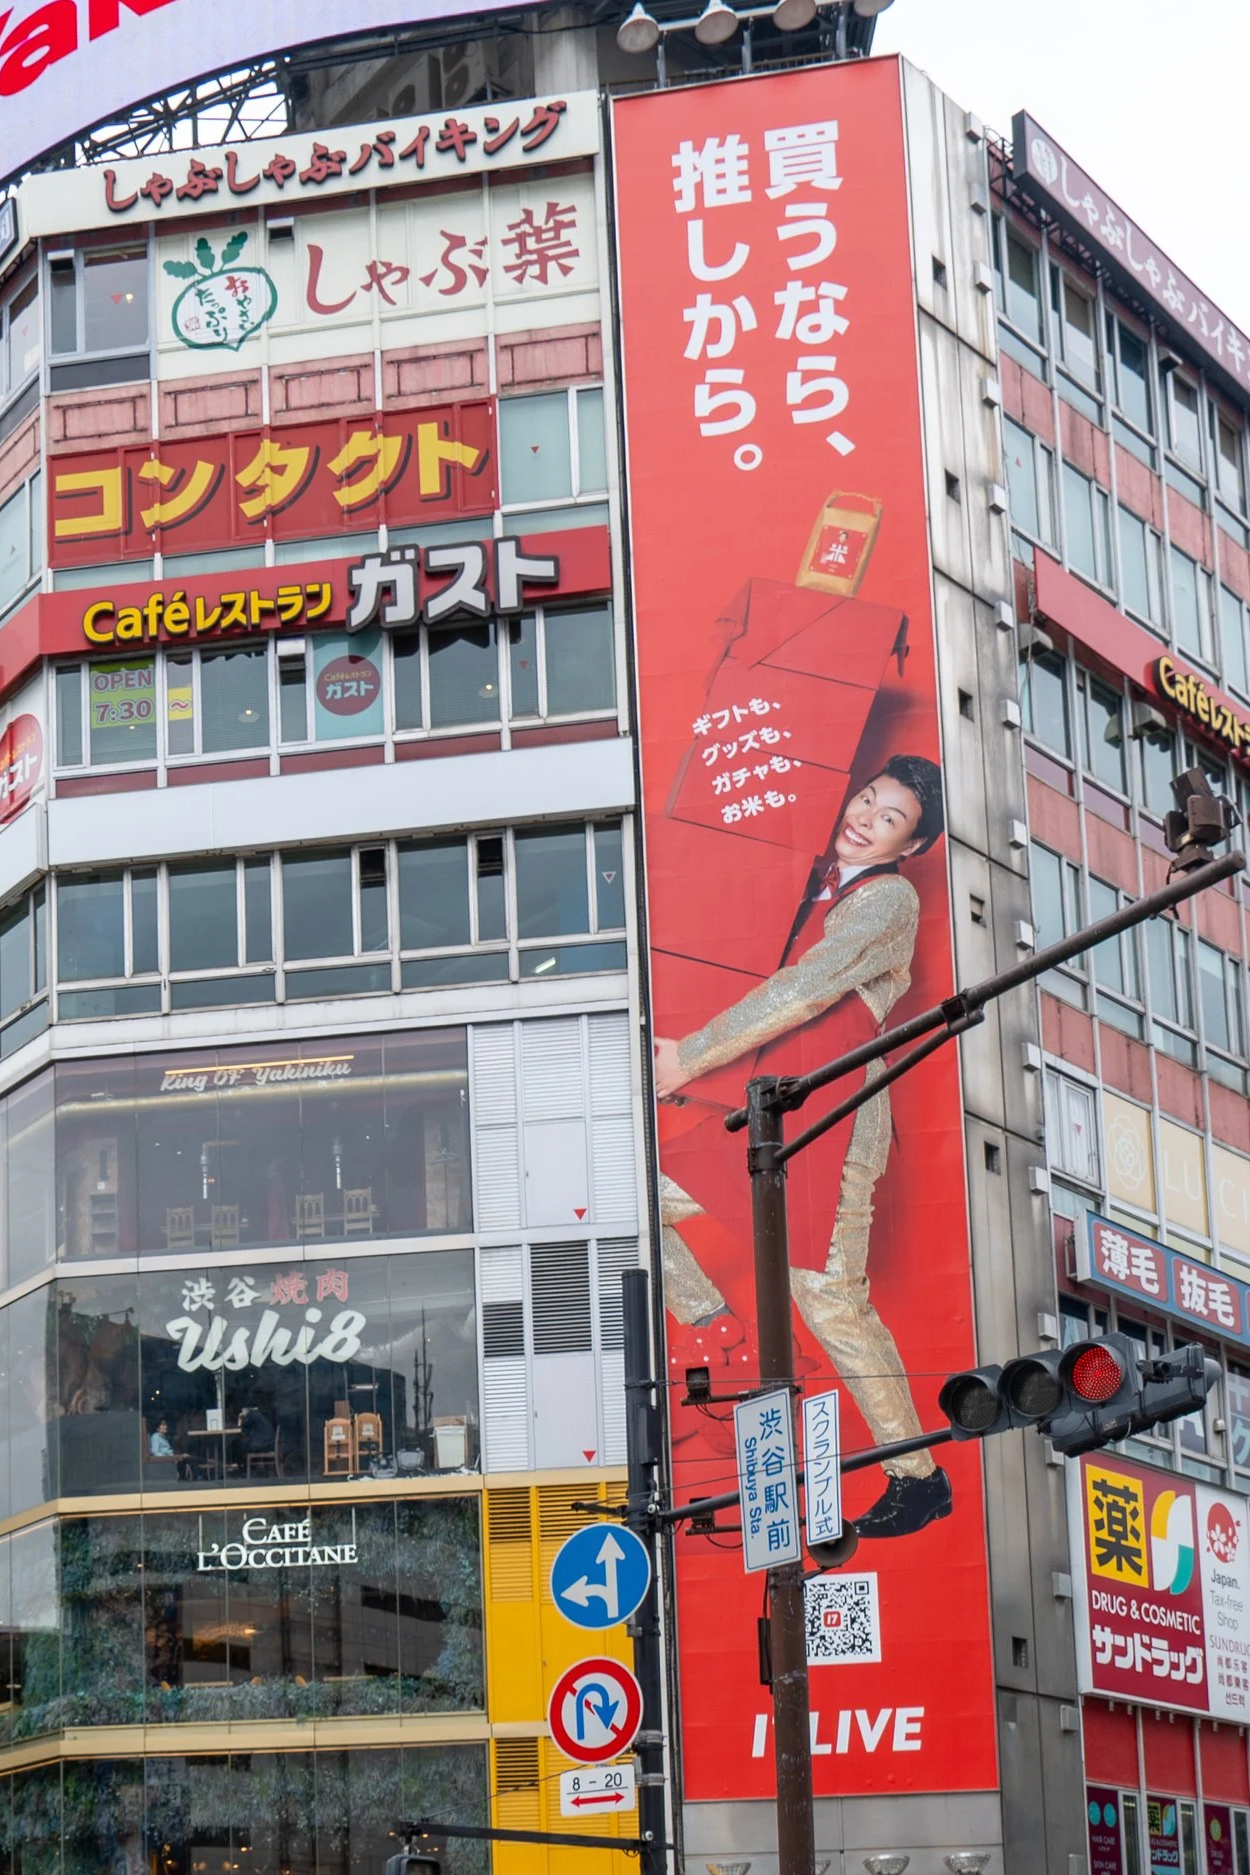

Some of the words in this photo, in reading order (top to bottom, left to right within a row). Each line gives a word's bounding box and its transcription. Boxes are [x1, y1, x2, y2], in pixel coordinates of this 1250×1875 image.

[103, 100, 567, 212] しゃぶしゃぶバイキング
[306, 200, 580, 316] しゃぶ葉
[763, 119, 856, 457] 買うなら、
[1060, 154, 1250, 383] しゃぶしゃぶバイキ
[671, 133, 763, 471] 推しから。
[54, 421, 490, 541] コンタクト
[349, 538, 558, 632] ガスト
[92, 668, 154, 693] OPEN
[325, 680, 375, 700] ガスト
[95, 699, 153, 726] 7:30
[692, 697, 782, 736] ギフトも、
[701, 726, 792, 767] グッズも、
[711, 754, 803, 796] ガチャも、
[720, 790, 797, 825] お米も。
[160, 1072, 208, 1092] King
[253, 1061, 352, 1087] Yakiniku
[1100, 1229, 1160, 1296] 薄毛
[1179, 1265, 1235, 1329] 抜毛
[165, 1307, 367, 1373] Ushi8
[744, 1438, 759, 1502] Shibuya
[759, 1407, 791, 1552] 渋谷駅前
[812, 1401, 834, 1537] スクランブル式
[749, 1506, 762, 1540] Sta.
[1092, 1478, 1143, 1577] 薬
[1209, 1590, 1244, 1613] Tax-free
[1210, 1569, 1241, 1591] Japan.
[1091, 1589, 1127, 1617] DRUG
[1130, 1599, 1140, 1620] &
[1141, 1602, 1201, 1636] COSMETIC
[1216, 1610, 1239, 1633] Shop
[1092, 1624, 1204, 1685] サンドラッグ
